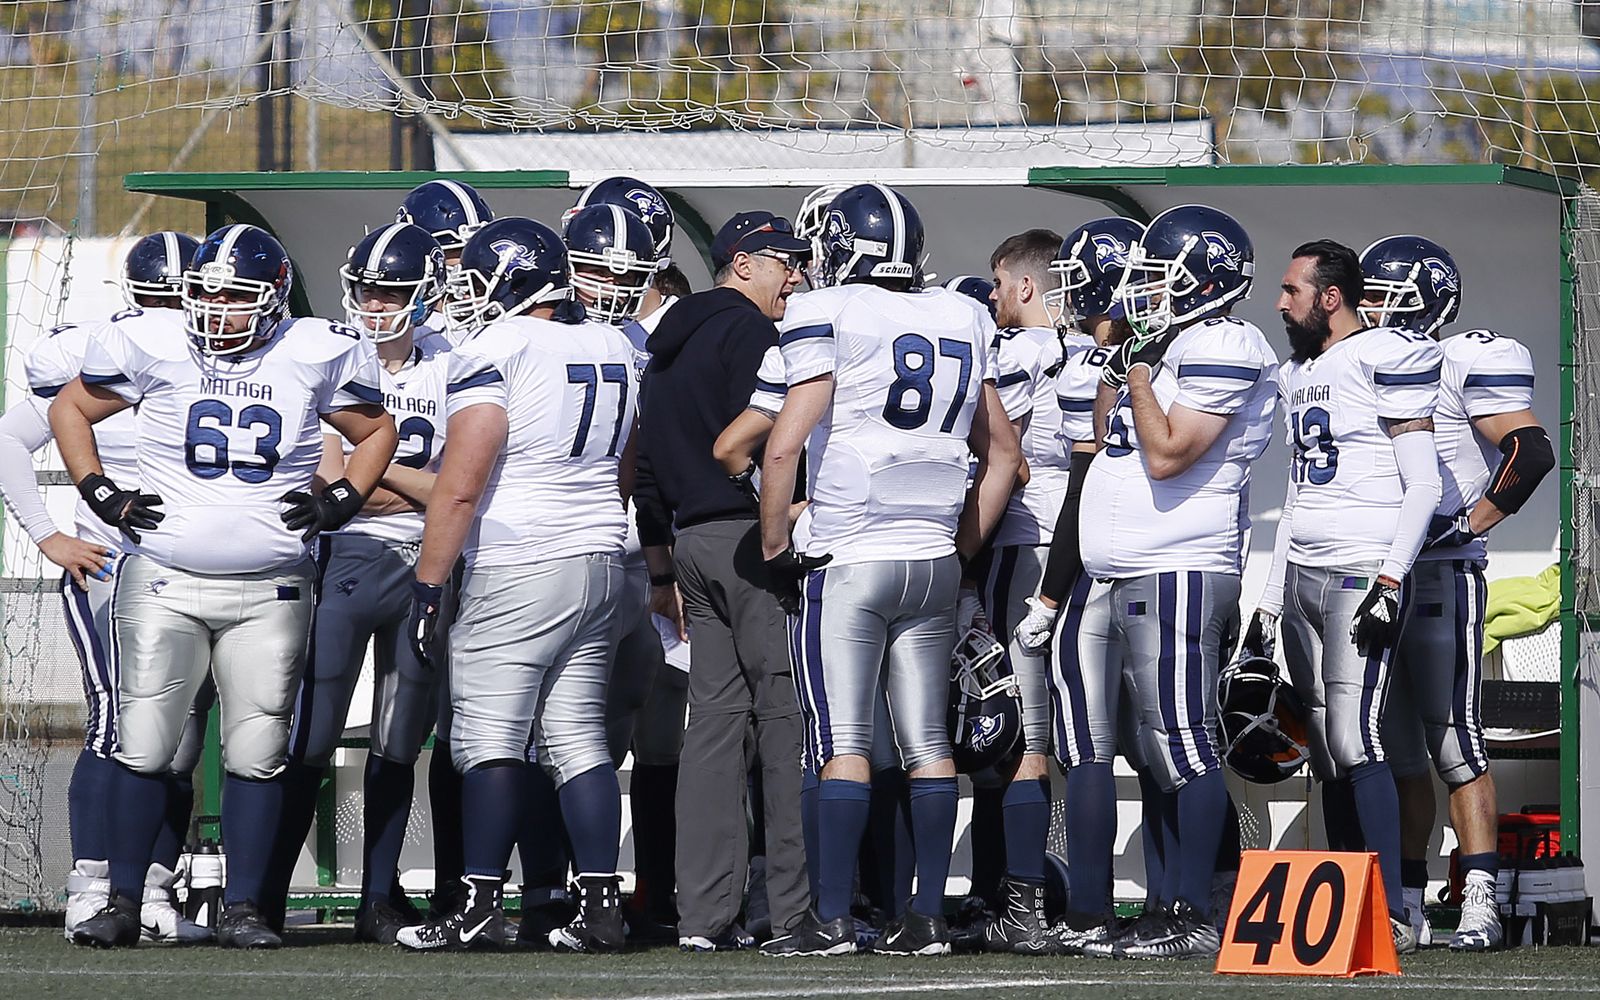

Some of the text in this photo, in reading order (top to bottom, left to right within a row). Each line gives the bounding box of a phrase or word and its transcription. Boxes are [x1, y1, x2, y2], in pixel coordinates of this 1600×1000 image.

[879, 265, 911, 274] schutt
[200, 377, 272, 401] MALAGA
[882, 332, 973, 434] 87
[1081, 347, 1112, 367] 16
[382, 393, 436, 416] ALAGA
[566, 363, 628, 457] 77
[184, 398, 282, 484] 63
[391, 415, 435, 469] 2
[1291, 406, 1340, 486] 13
[1232, 861, 1346, 966] 40
